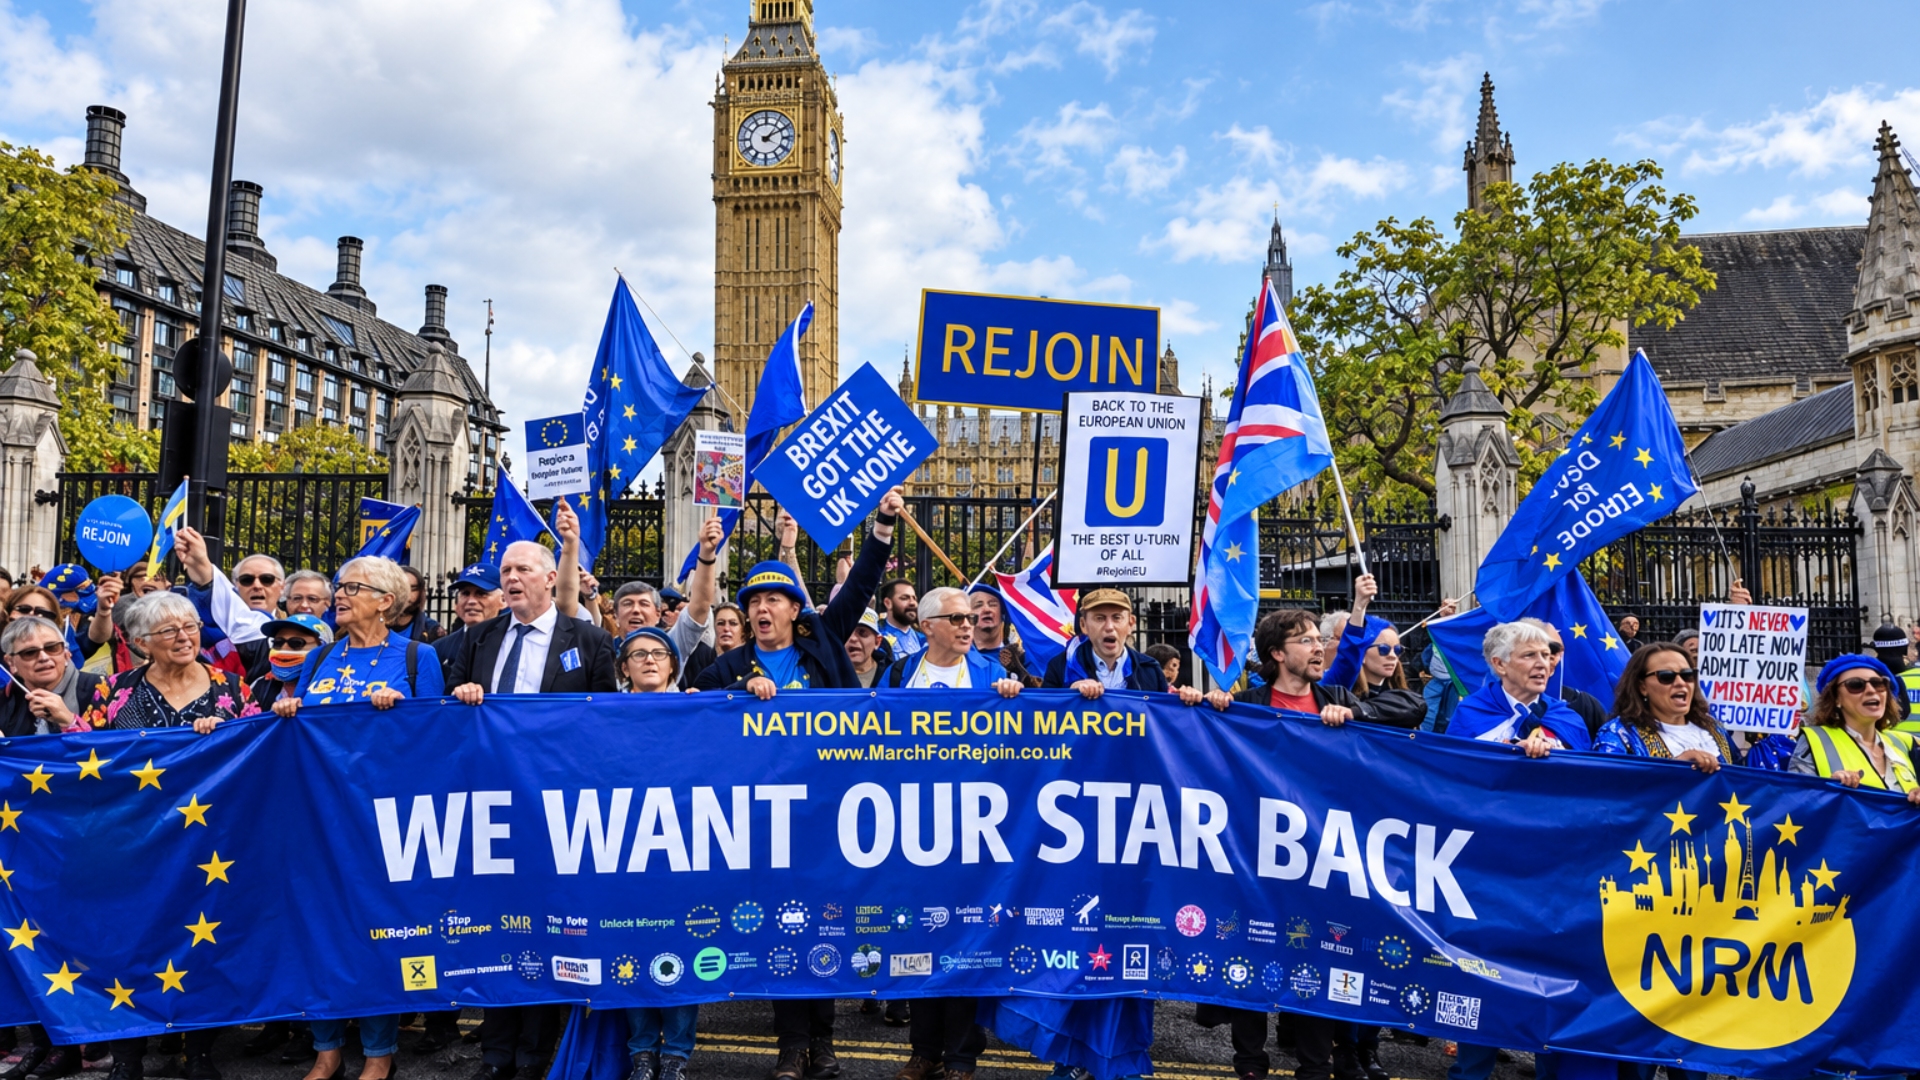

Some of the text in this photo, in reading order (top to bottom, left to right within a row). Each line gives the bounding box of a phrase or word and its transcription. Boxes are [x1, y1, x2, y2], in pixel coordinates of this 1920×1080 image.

[942, 323, 1143, 385] REJOIN
[1092, 400, 1174, 414] BACK TO THE
[785, 390, 861, 471] BREXIT
[1079, 415, 1186, 430] EUROPEAN UNION
[803, 409, 892, 499] GOT THE
[819, 431, 916, 526] UK NONE
[1104, 447, 1149, 518] U
[82, 525, 131, 547] REJOIN
[1071, 534, 1180, 546] THE BEST U-TURN
[1100, 549, 1145, 561] OF ALL
[1748, 611, 1789, 632] NEVER
[1702, 632, 1805, 656] TOO LATE NOW
[1700, 655, 1799, 682] ADMIT YOUR
[1712, 681, 1799, 707] MISTAKES
[742, 711, 1146, 737] NATIONAL REJOIN MARCH
[817, 743, 1073, 764] www.MarchForRejoin.co.uk
[373, 780, 1478, 920] WE WANT OUR STAR BACK
[501, 914, 532, 930] SMR
[1041, 949, 1080, 970] Volt
[1640, 932, 1814, 1005] NRM
